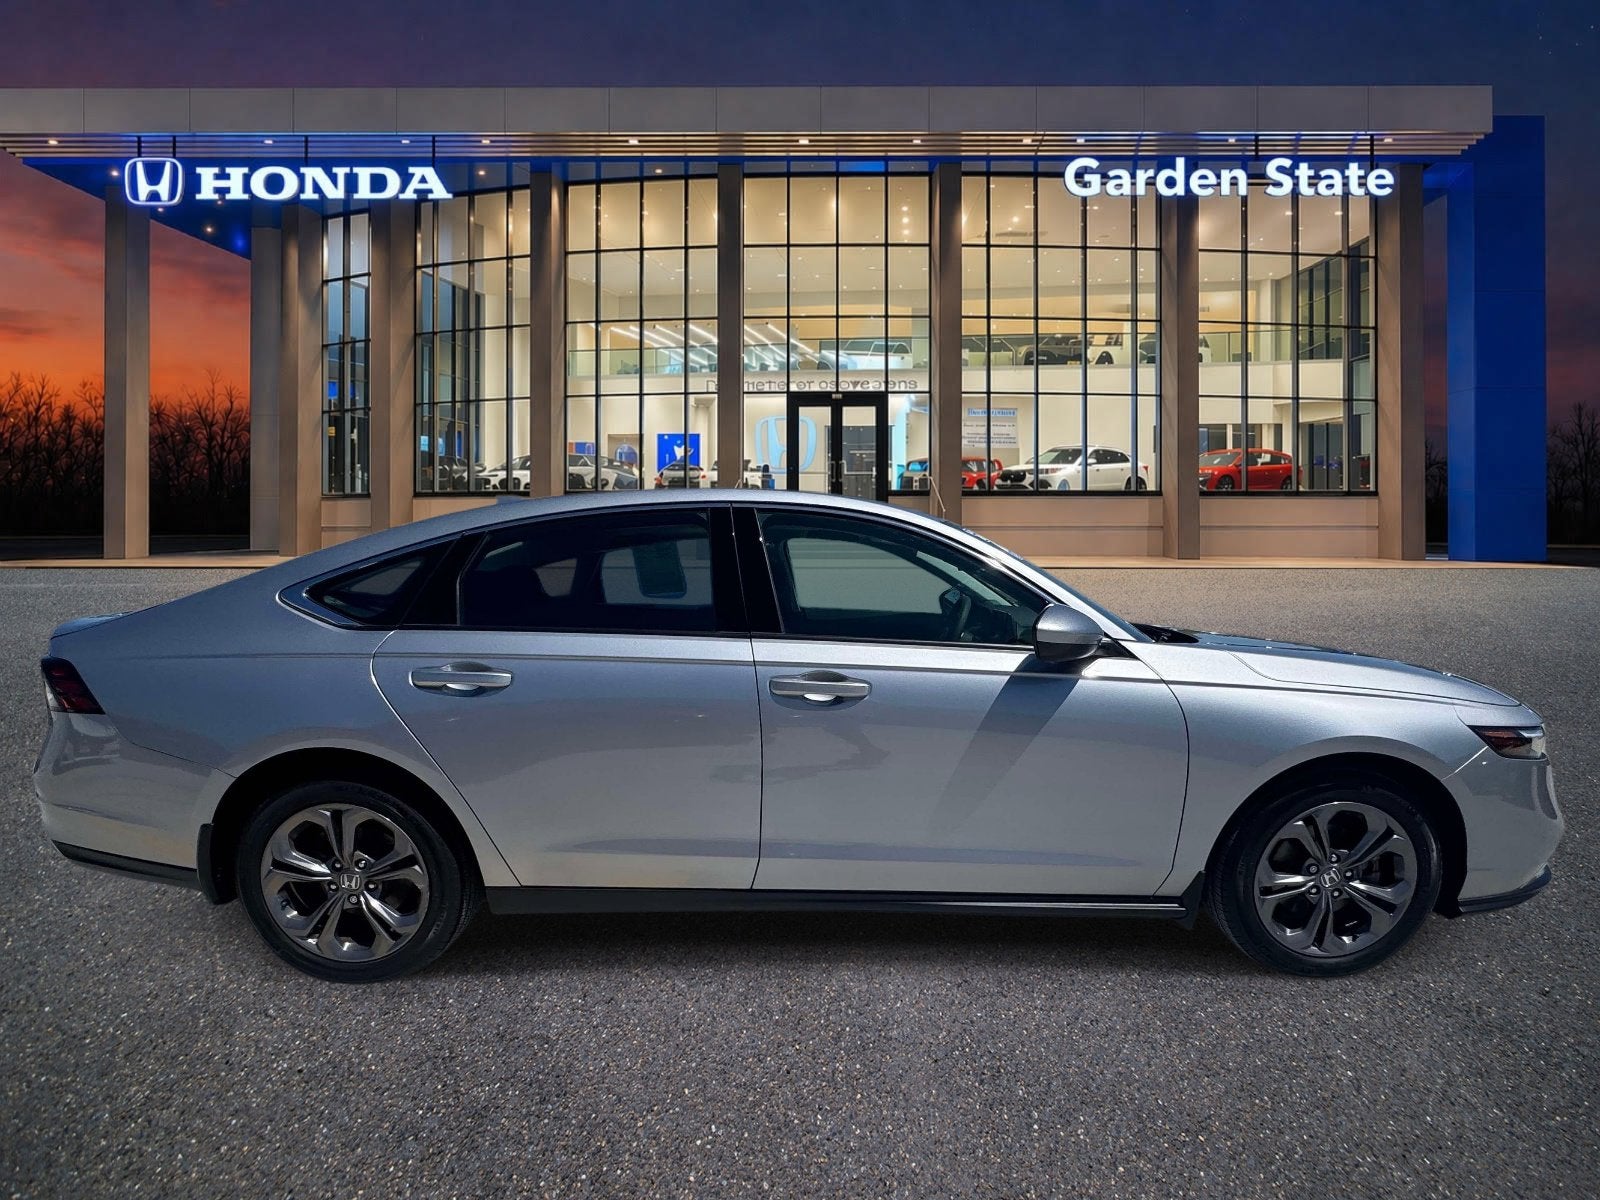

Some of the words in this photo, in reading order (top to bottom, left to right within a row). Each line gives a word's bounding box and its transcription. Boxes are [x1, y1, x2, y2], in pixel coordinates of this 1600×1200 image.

[195, 166, 453, 200] HONDA
[1064, 157, 1247, 197] Garden
[1265, 157, 1395, 197] State
